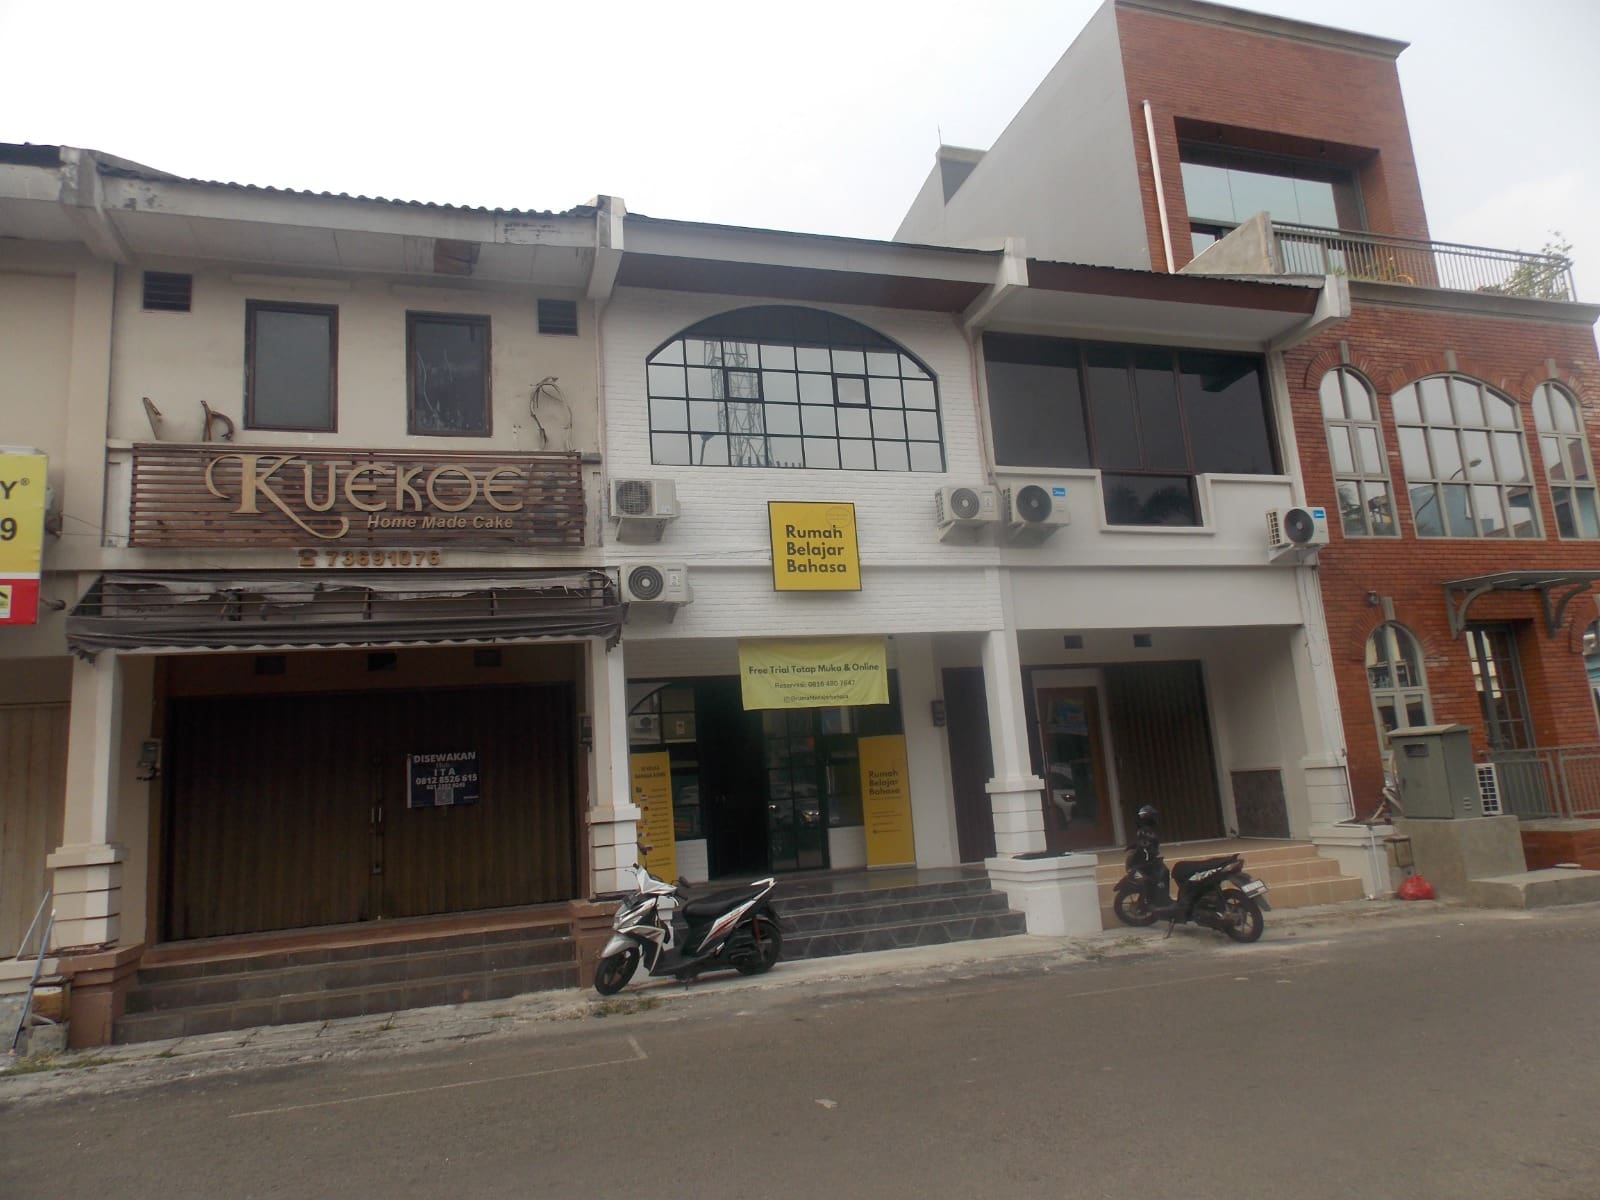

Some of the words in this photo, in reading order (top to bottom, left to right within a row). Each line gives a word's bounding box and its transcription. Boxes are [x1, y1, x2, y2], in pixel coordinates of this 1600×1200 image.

[367, 514, 416, 529] Home
[422, 514, 466, 530] Made
[472, 515, 513, 530] Cake
[785, 525, 843, 539] Rumah
[786, 542, 845, 560] Belajar
[326, 549, 441, 567] 73691076
[786, 559, 847, 573] Bahasa
[748, 666, 768, 674] Free
[769, 665, 789, 674] Trial
[791, 665, 816, 675] Tatap
[818, 663, 842, 672] Muka
[844, 663, 851, 671] &
[852, 662, 880, 671] Online
[413, 752, 476, 763] DISEWAKAN
[868, 769, 899, 778] Rumah
[869, 779, 898, 788] Belajar
[869, 788, 901, 796] Bahasa
